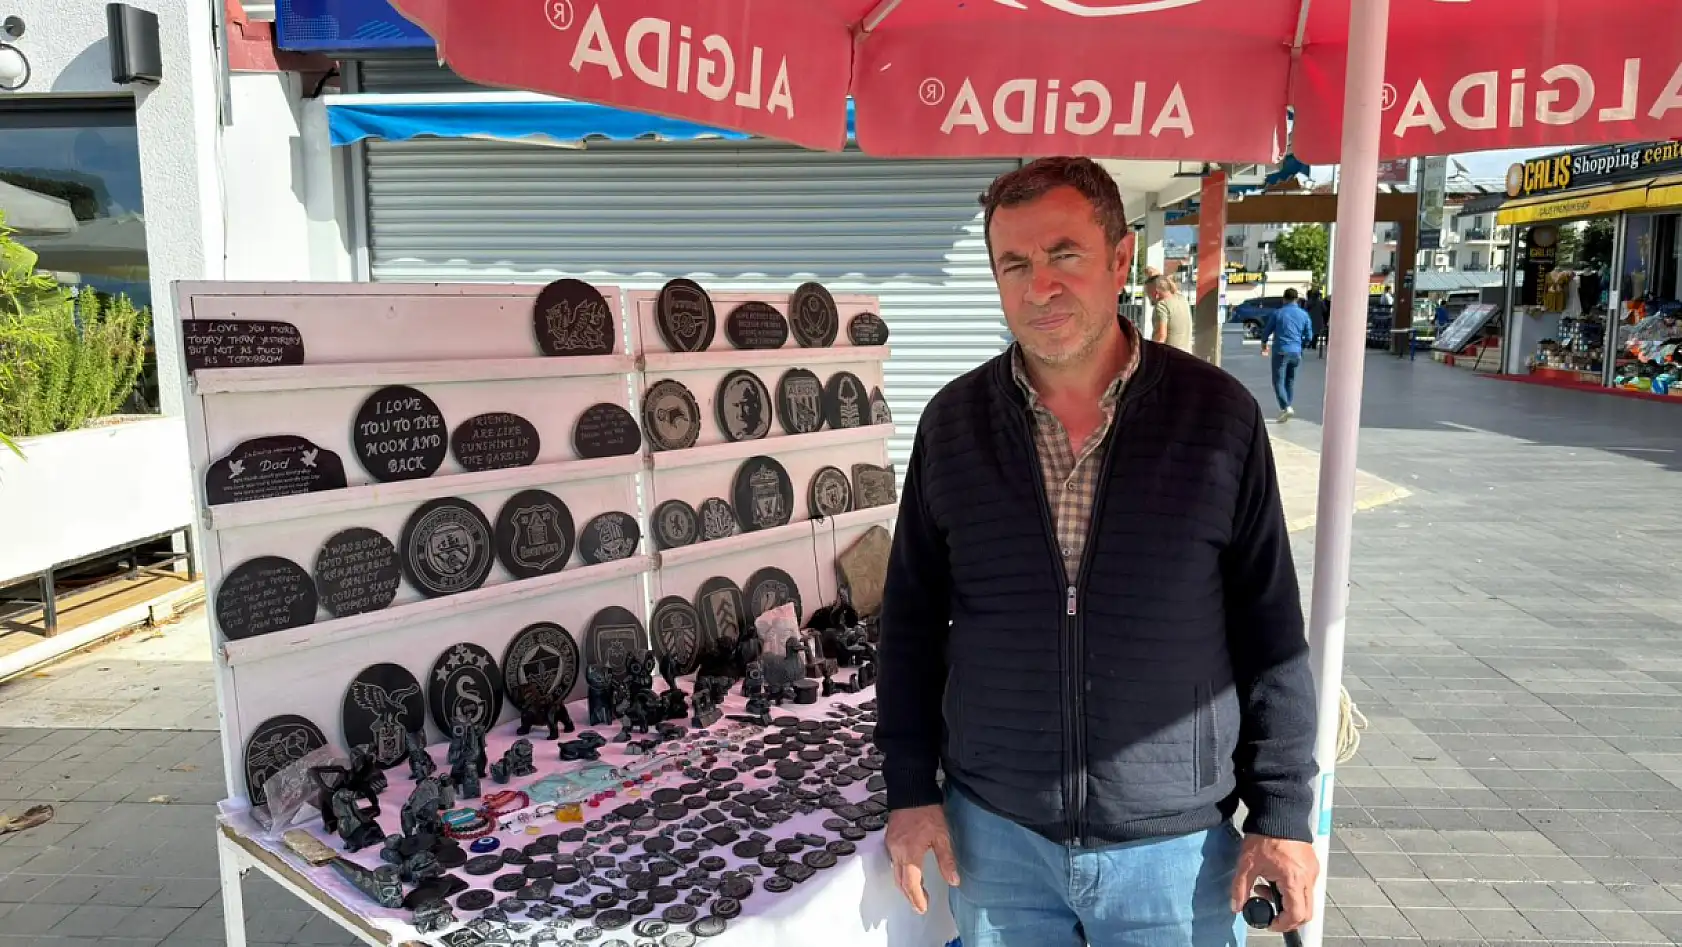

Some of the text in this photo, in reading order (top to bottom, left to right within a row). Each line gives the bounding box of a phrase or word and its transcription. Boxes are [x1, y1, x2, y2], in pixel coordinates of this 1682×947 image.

[1573, 148, 1641, 175] Shopping
[192, 323, 197, 332] I
[208, 322, 239, 333] LOVE
[187, 335, 222, 345] TODAY
[188, 346, 208, 355] BUT
[213, 346, 234, 355] NOT
[227, 355, 282, 364] TOMORROW
[376, 397, 422, 414] I LOVE
[393, 417, 410, 432] TO
[413, 415, 440, 430] THE
[470, 415, 515, 426] FRIENDS
[472, 426, 521, 440] ARE LIKE
[366, 435, 440, 456] MOON AND
[461, 436, 530, 453] SUNSHINE IN
[260, 458, 290, 471] Dad
[388, 457, 426, 472] BACK
[462, 451, 528, 465] THE GARDEN
[331, 543, 353, 555] WAS
[355, 537, 381, 550] BORN
[331, 587, 365, 603] COULD
